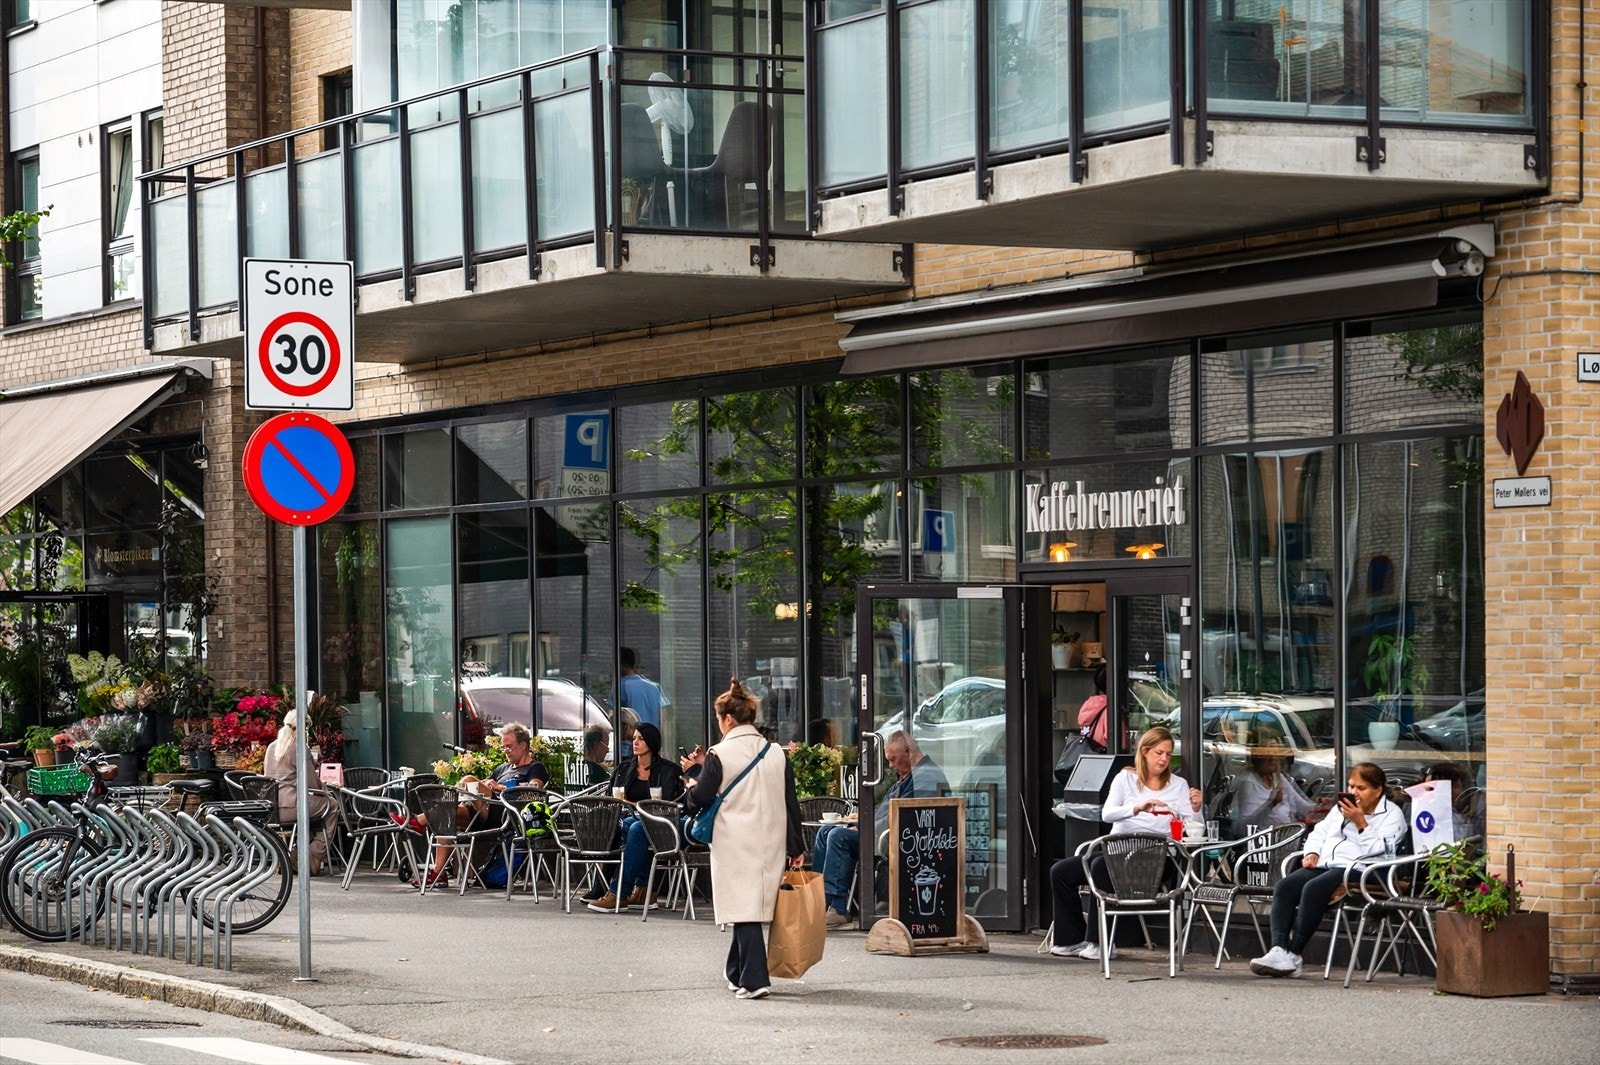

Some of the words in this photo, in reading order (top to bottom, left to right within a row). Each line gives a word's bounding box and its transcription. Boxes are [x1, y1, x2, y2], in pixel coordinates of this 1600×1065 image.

[264, 269, 333, 296] Sone
[275, 333, 326, 375] 30
[1026, 475, 1186, 533] Kaffebrenneriet
[1496, 488, 1511, 498] Peter
[1514, 487, 1536, 497] Møllers
[1539, 486, 1548, 496] vei
[561, 753, 589, 785] Kaffe
[915, 809, 935, 828] VARM
[911, 924, 926, 935] FRA
